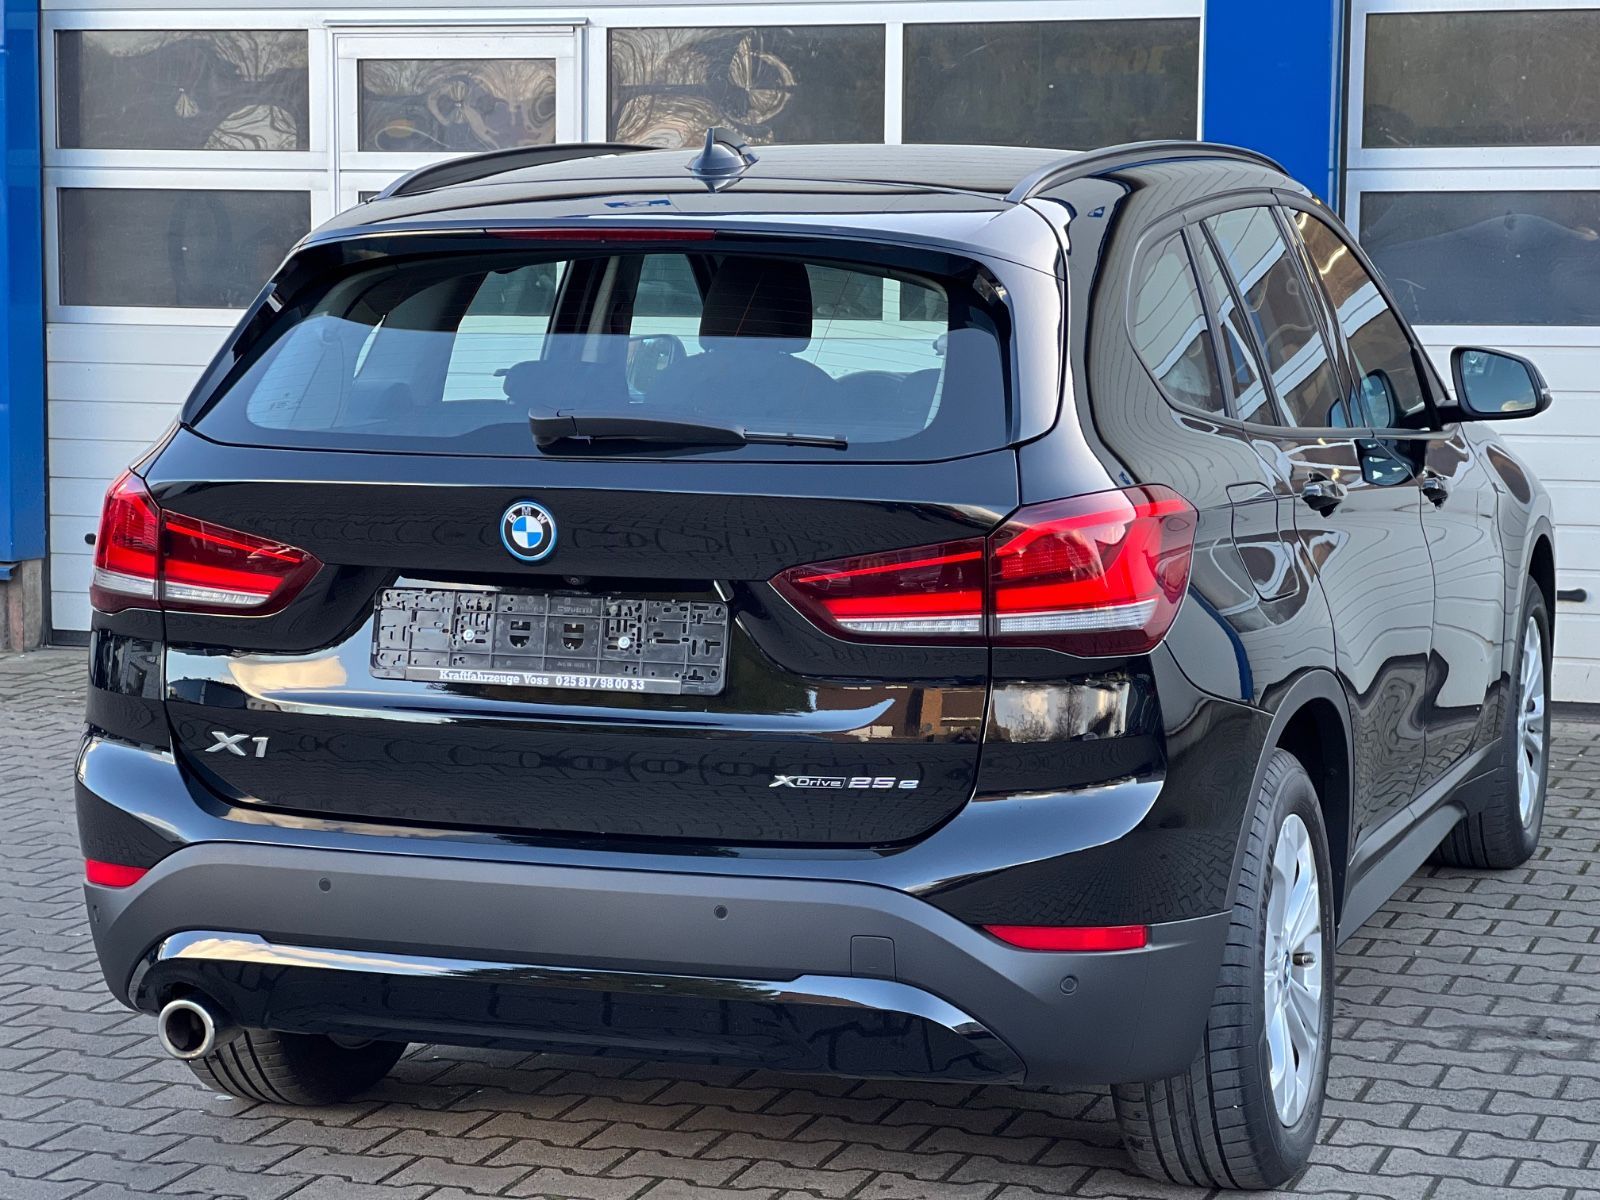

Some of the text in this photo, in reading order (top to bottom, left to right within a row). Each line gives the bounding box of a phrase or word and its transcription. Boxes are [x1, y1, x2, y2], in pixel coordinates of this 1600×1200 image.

[507, 506, 548, 524] BMW
[439, 670, 520, 686] Kraftfahrzeuge
[523, 673, 549, 685] Voss
[205, 730, 269, 758] X1
